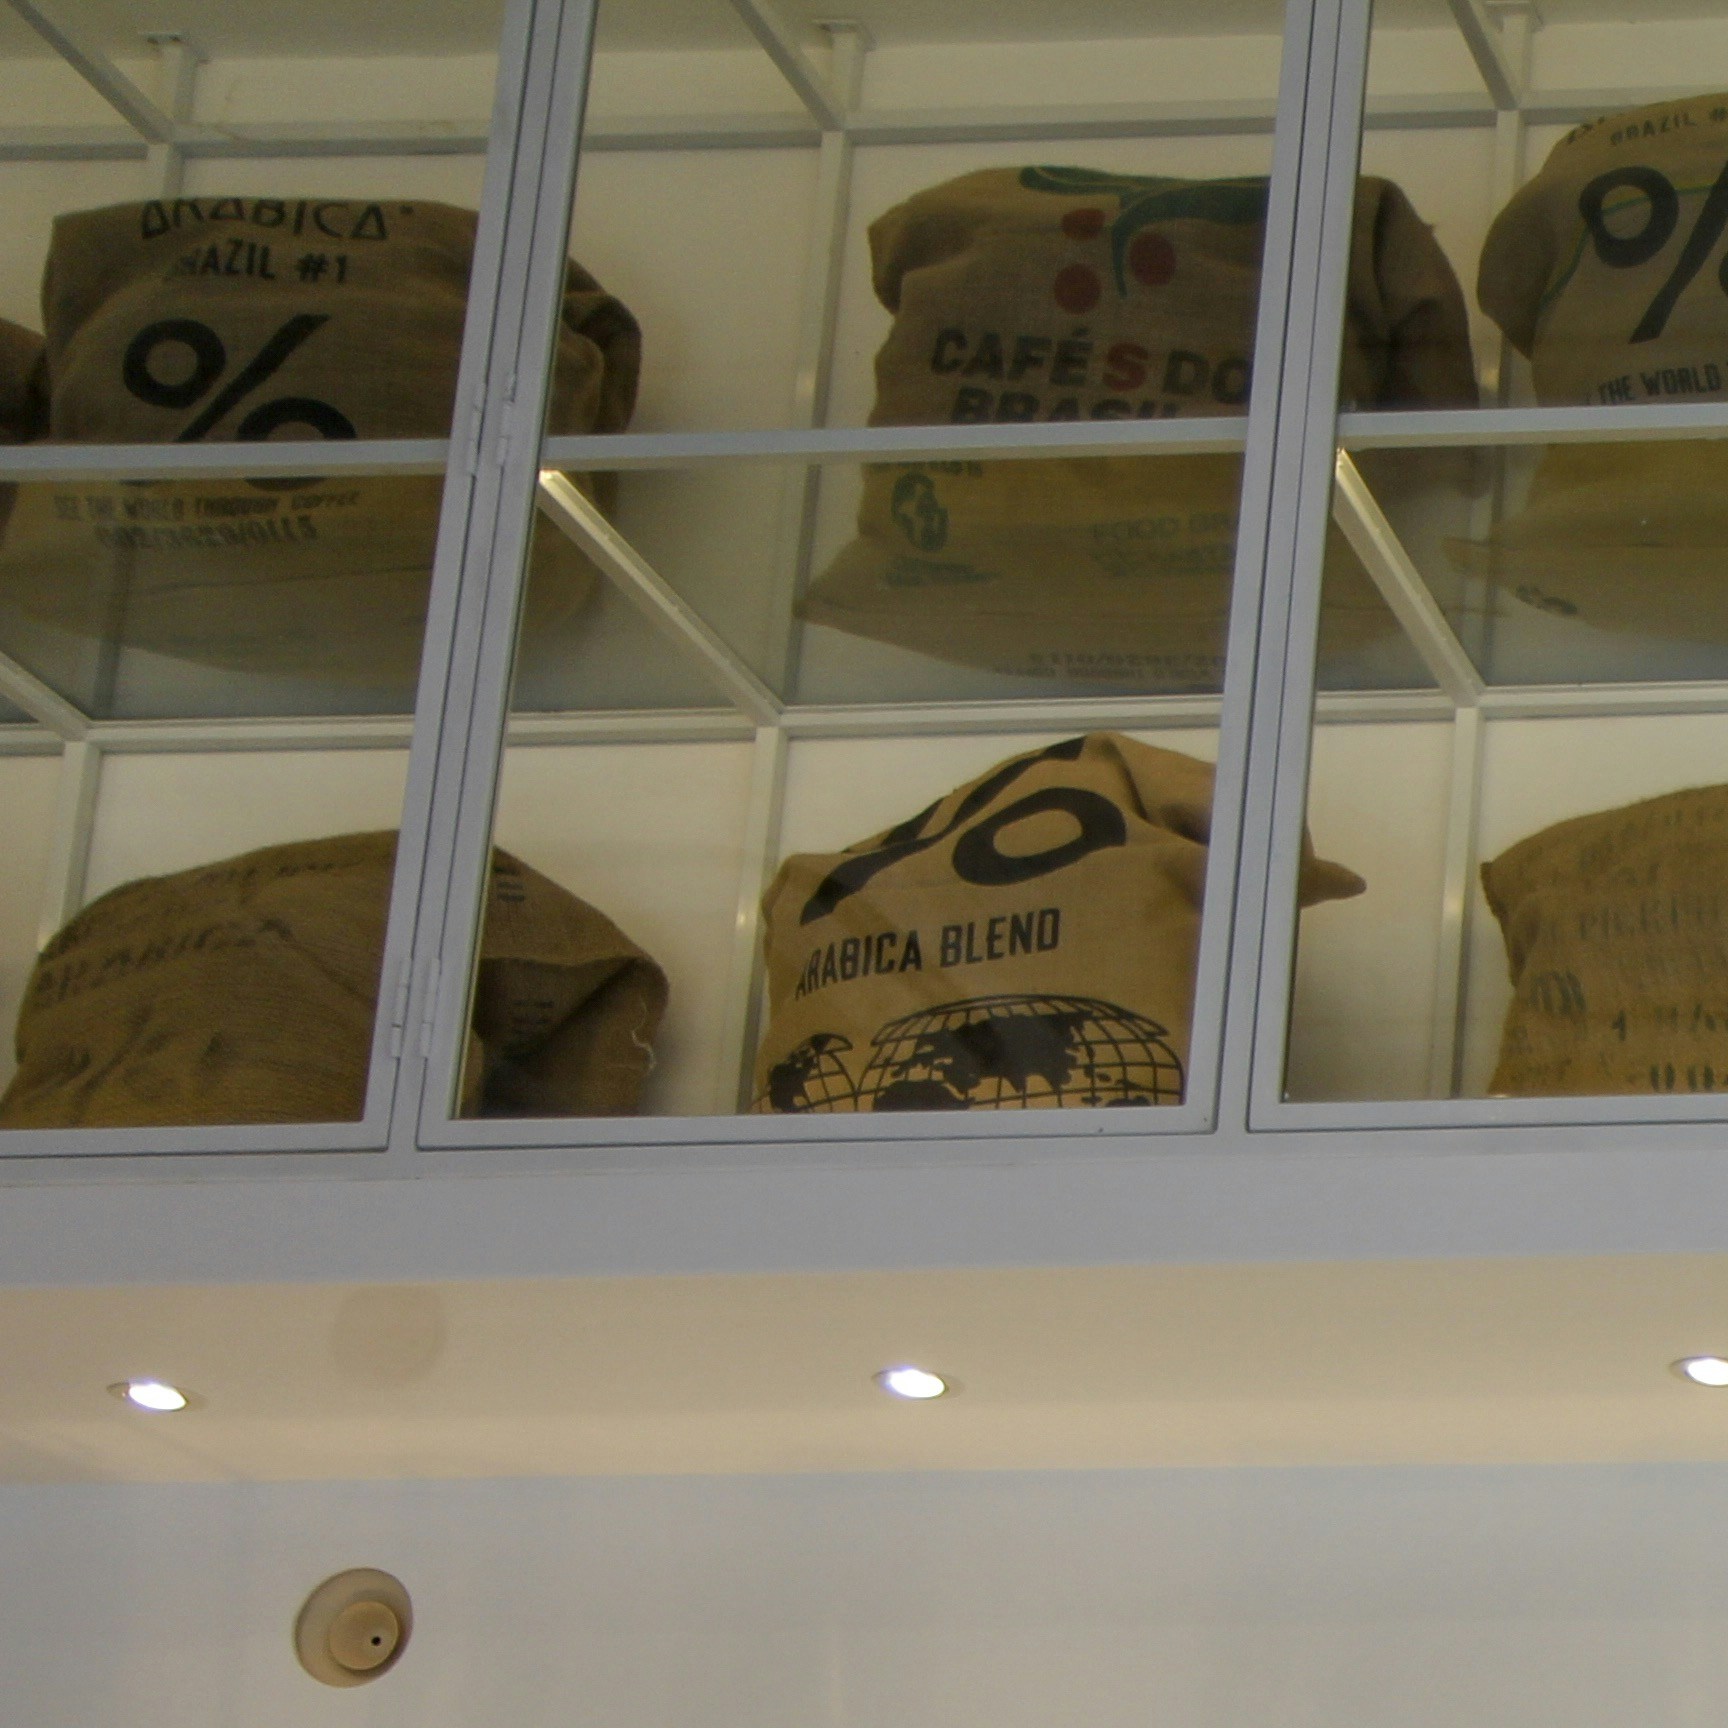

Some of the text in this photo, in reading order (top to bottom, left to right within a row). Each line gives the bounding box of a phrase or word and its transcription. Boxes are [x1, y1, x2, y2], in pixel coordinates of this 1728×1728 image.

[1609, 110, 1698, 146] BRAZIL
[141, 199, 377, 240] ARABICA
[298, 252, 348, 284] #1
[931, 326, 1150, 393] CAFÉS
[1161, 349, 1251, 404] DO
[1640, 362, 1722, 396] WORLD
[795, 908, 1061, 1001] ARABICA BLEND
